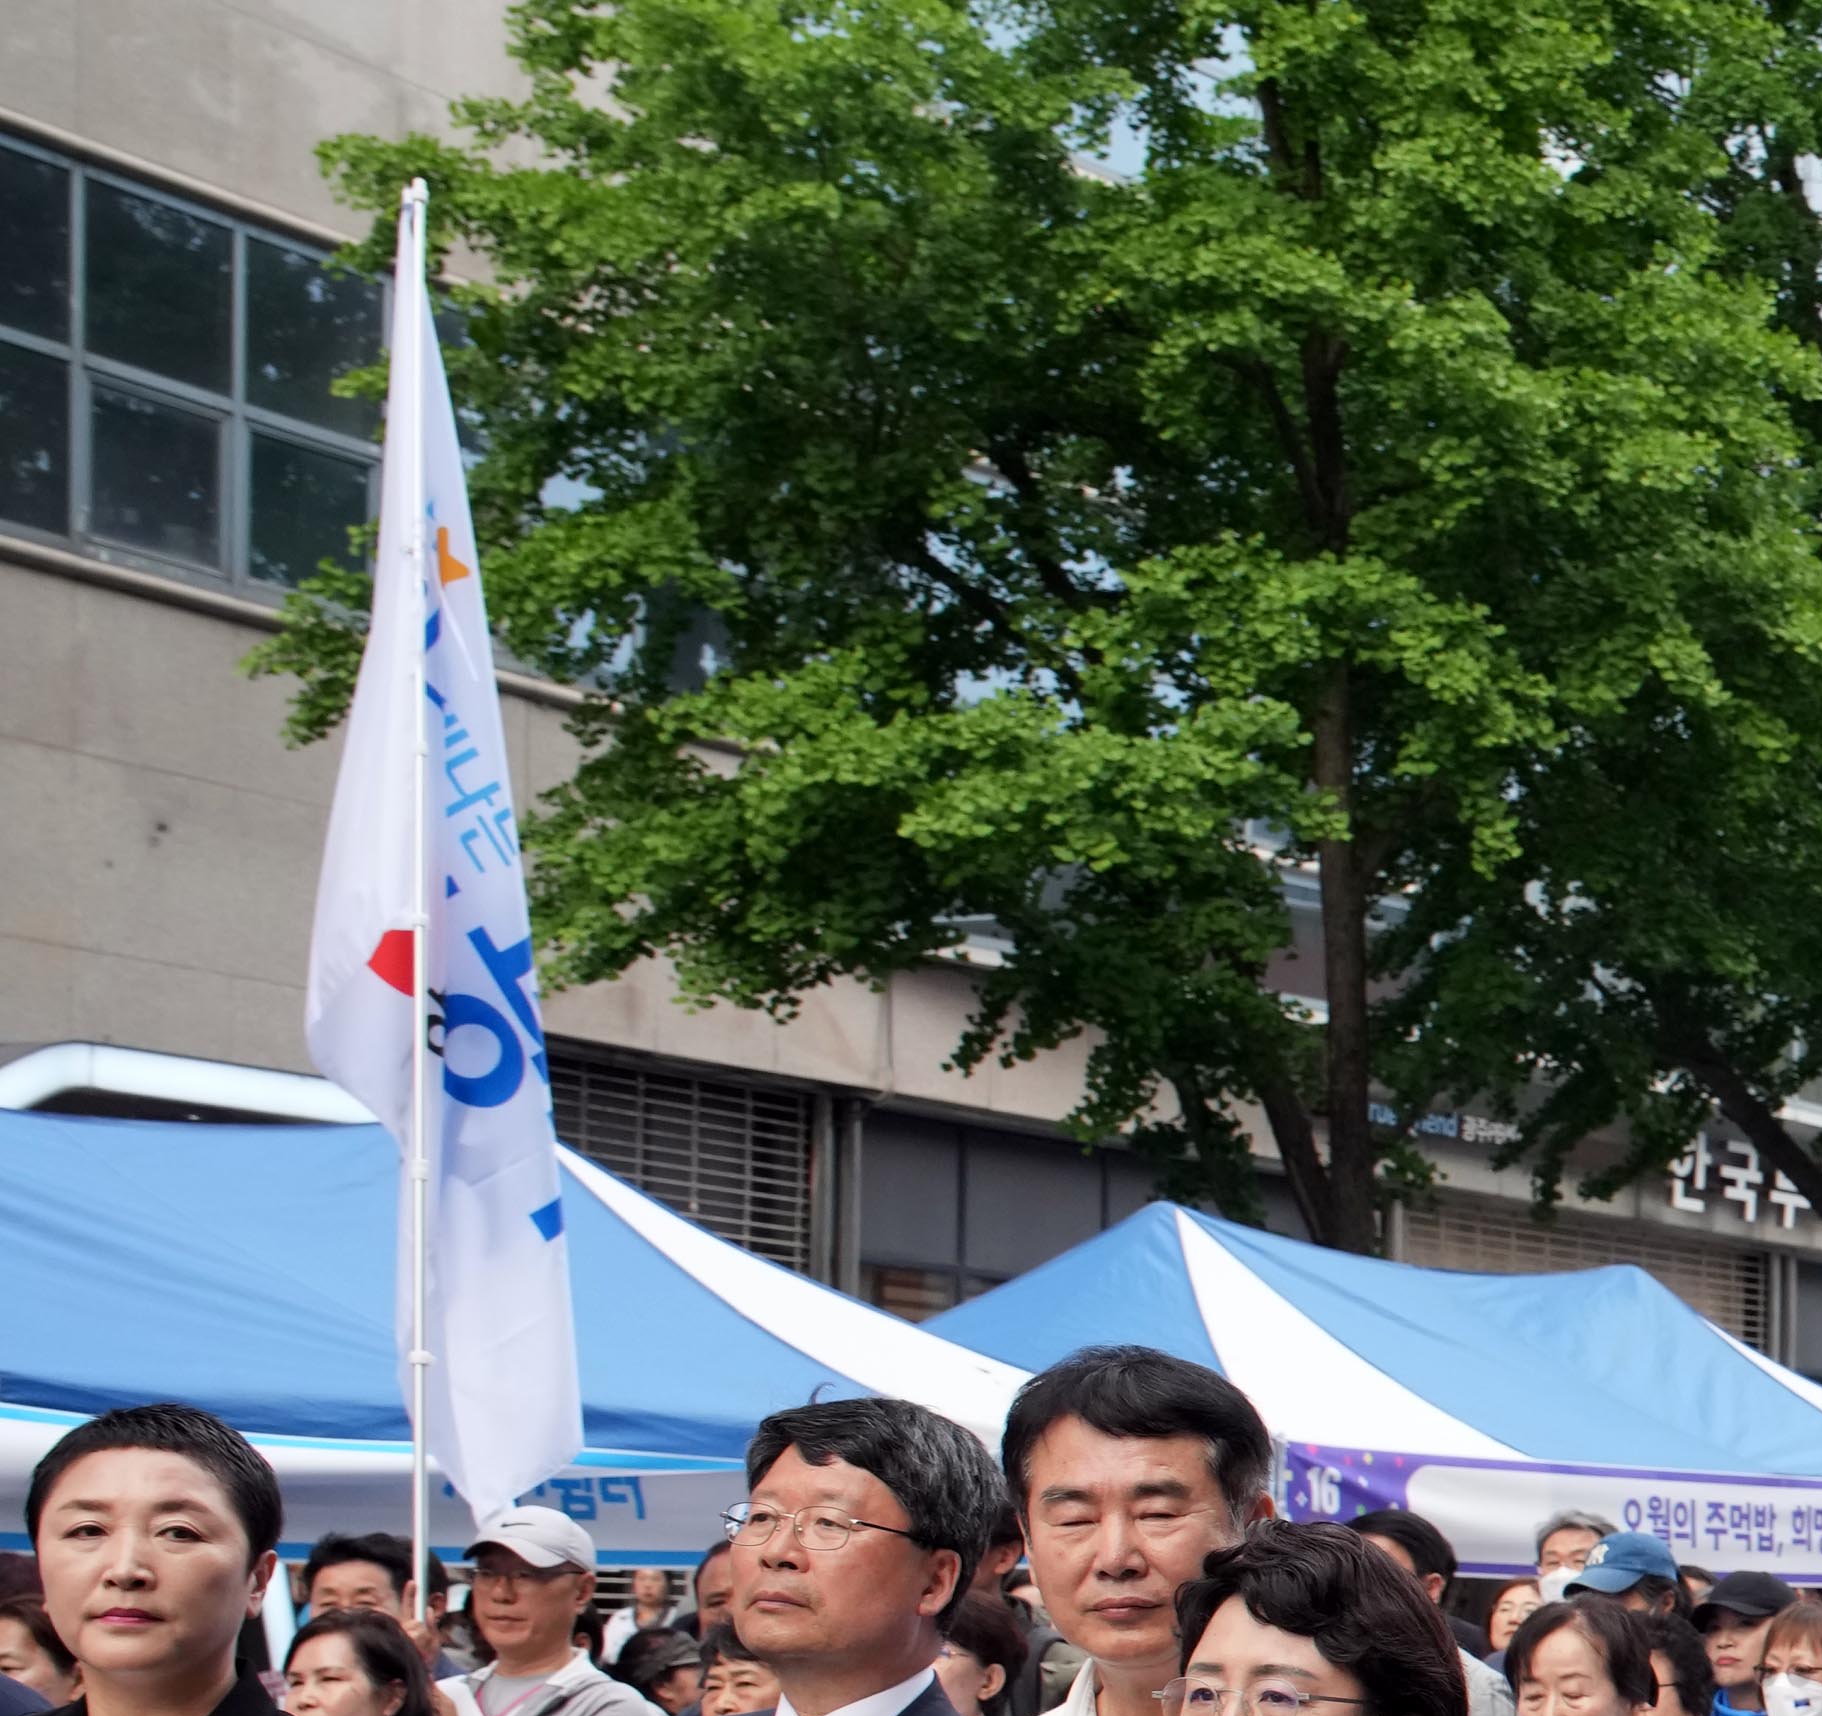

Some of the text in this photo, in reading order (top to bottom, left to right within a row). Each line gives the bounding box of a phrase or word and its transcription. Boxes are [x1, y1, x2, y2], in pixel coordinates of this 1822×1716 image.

[1307, 1466, 1341, 1515] 16
[1623, 1496, 1696, 1549] 오월의
[1704, 1501, 1783, 1557] 주먹밥,
